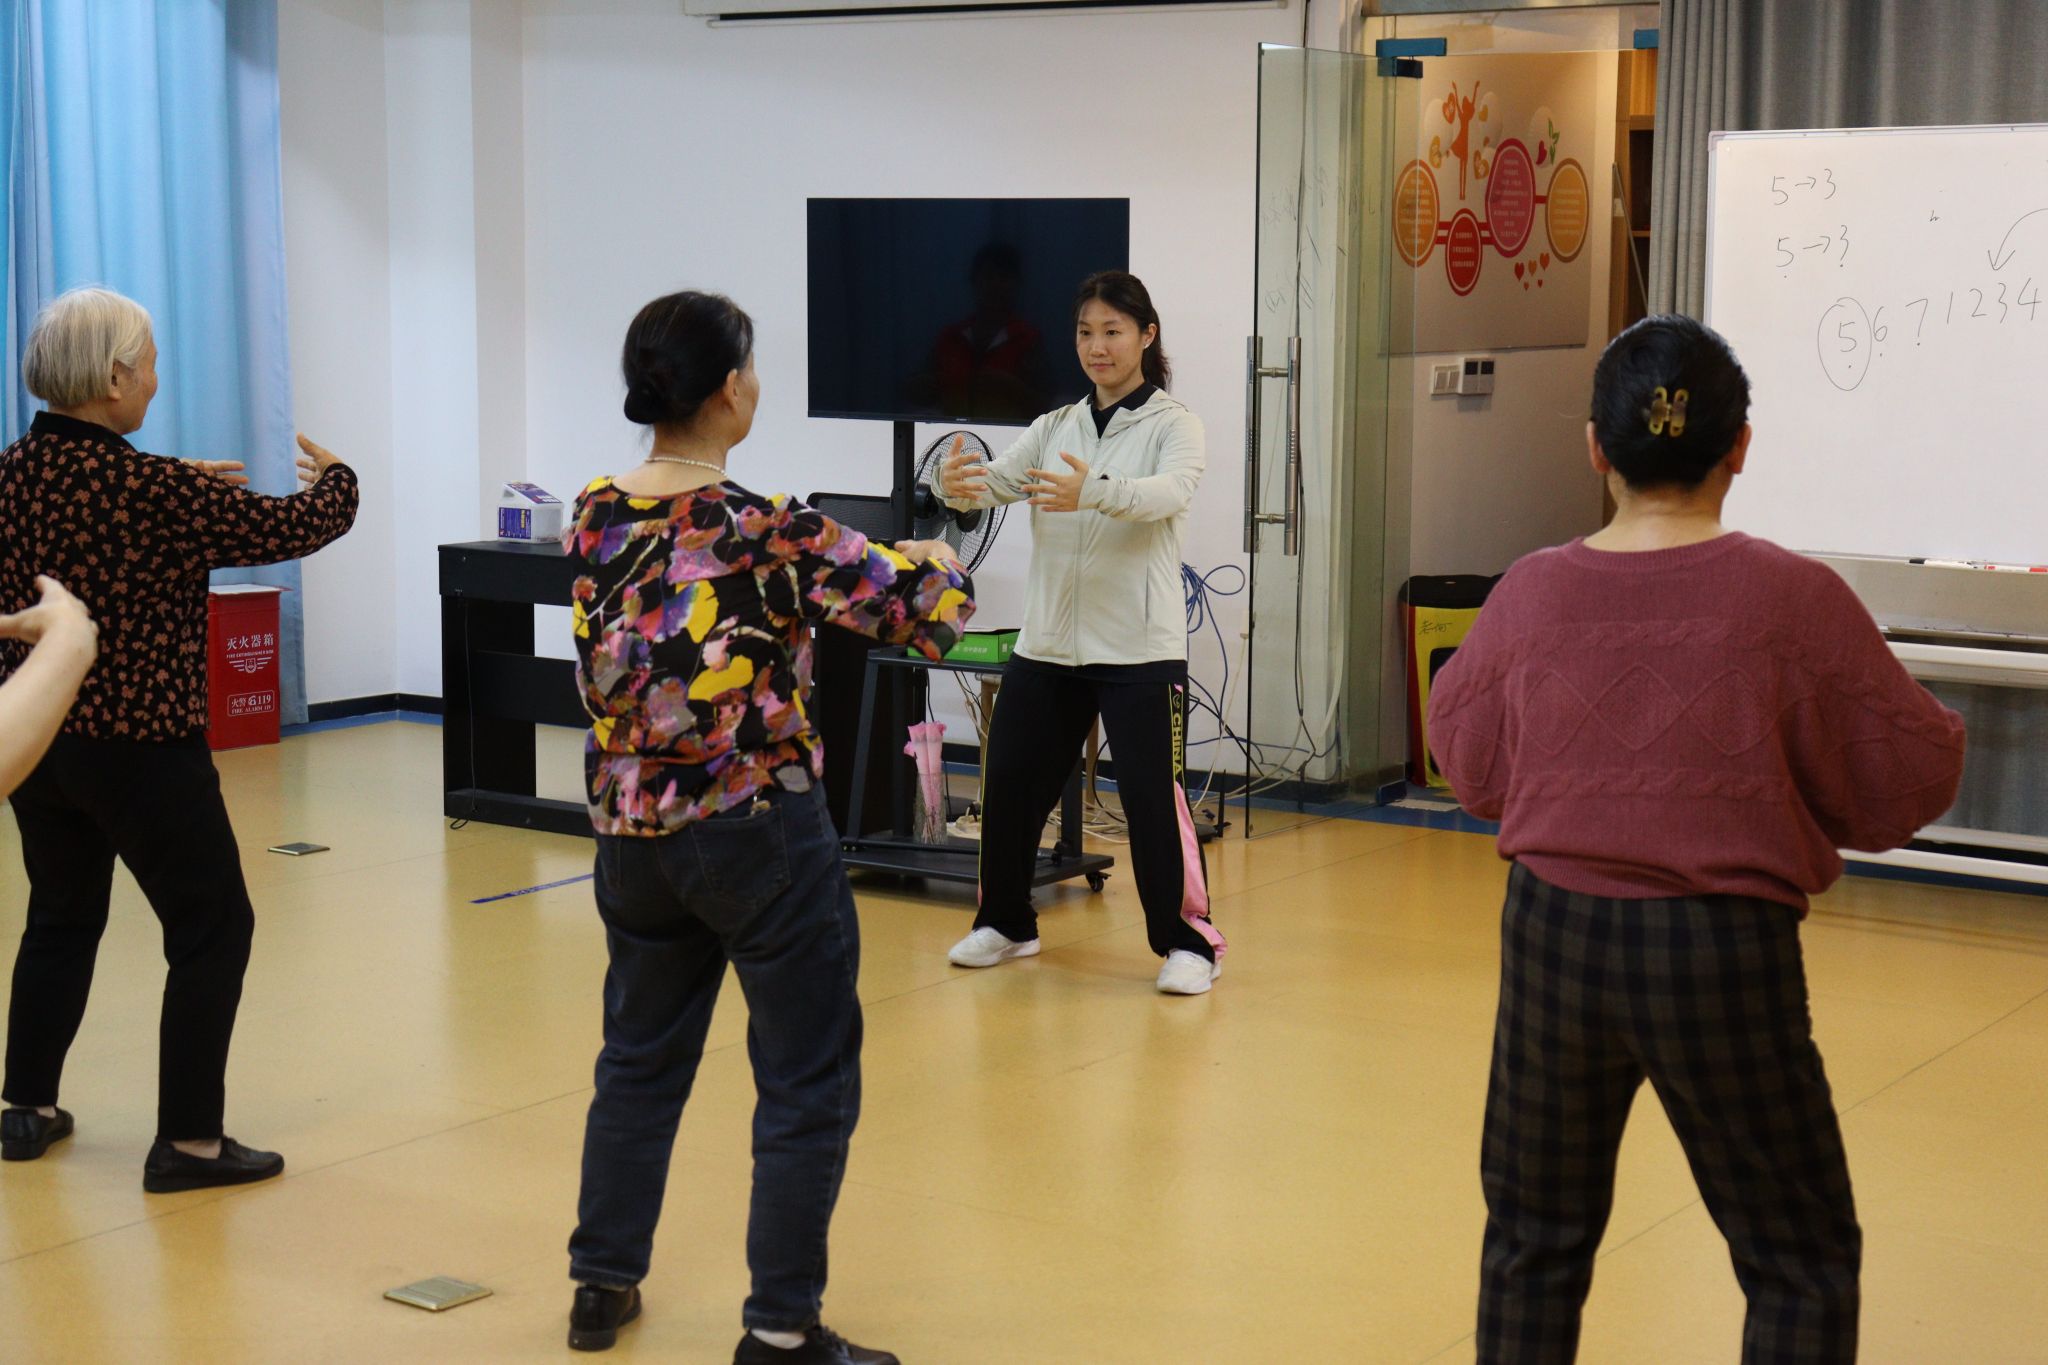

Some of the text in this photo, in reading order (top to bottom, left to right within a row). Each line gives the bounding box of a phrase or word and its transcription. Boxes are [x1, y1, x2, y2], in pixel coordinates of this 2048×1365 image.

[227, 633, 274, 651] 灭火器箱
[258, 694, 271, 705] 119
[1173, 712, 1182, 775] CHINA
